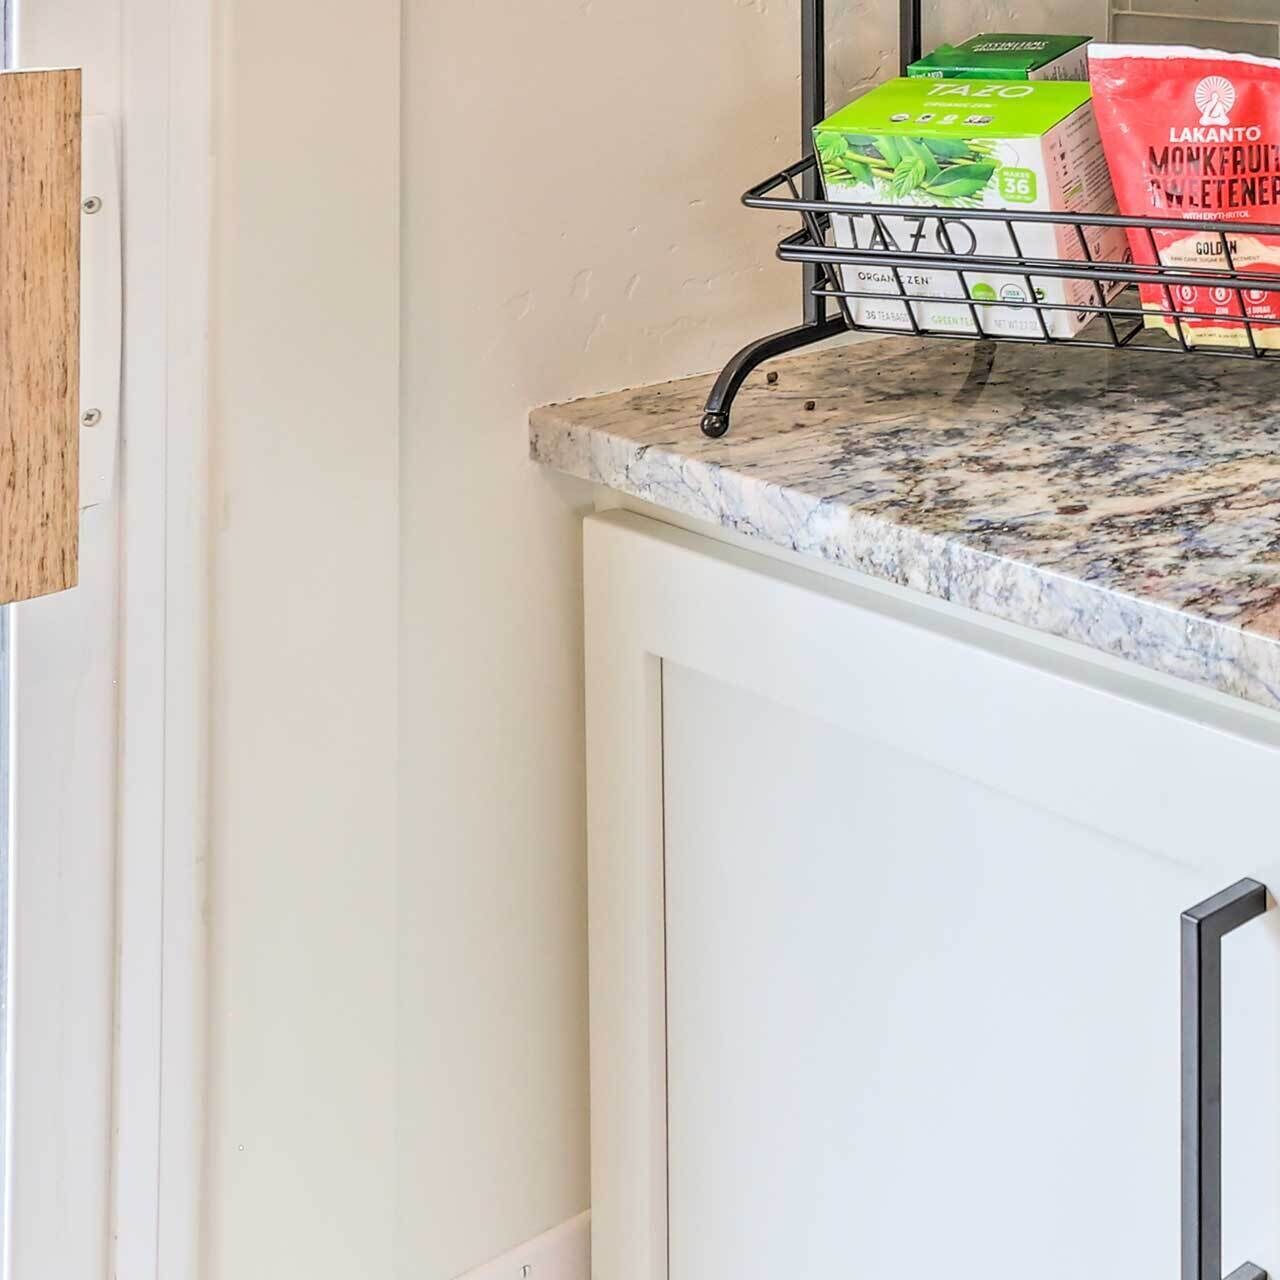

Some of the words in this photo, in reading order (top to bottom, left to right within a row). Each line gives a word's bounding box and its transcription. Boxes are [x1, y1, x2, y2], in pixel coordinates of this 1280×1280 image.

[927, 83, 1035, 99] TAZO
[1169, 126, 1261, 143] LAKANTO
[1148, 144, 1280, 176] MONKFRUIT
[1003, 177, 1029, 195] 36
[1182, 211, 1204, 220] WITH
[1196, 240, 1238, 256] GOLDN
[857, 271, 904, 285] ORGANC
[906, 276, 929, 286] ZEN
